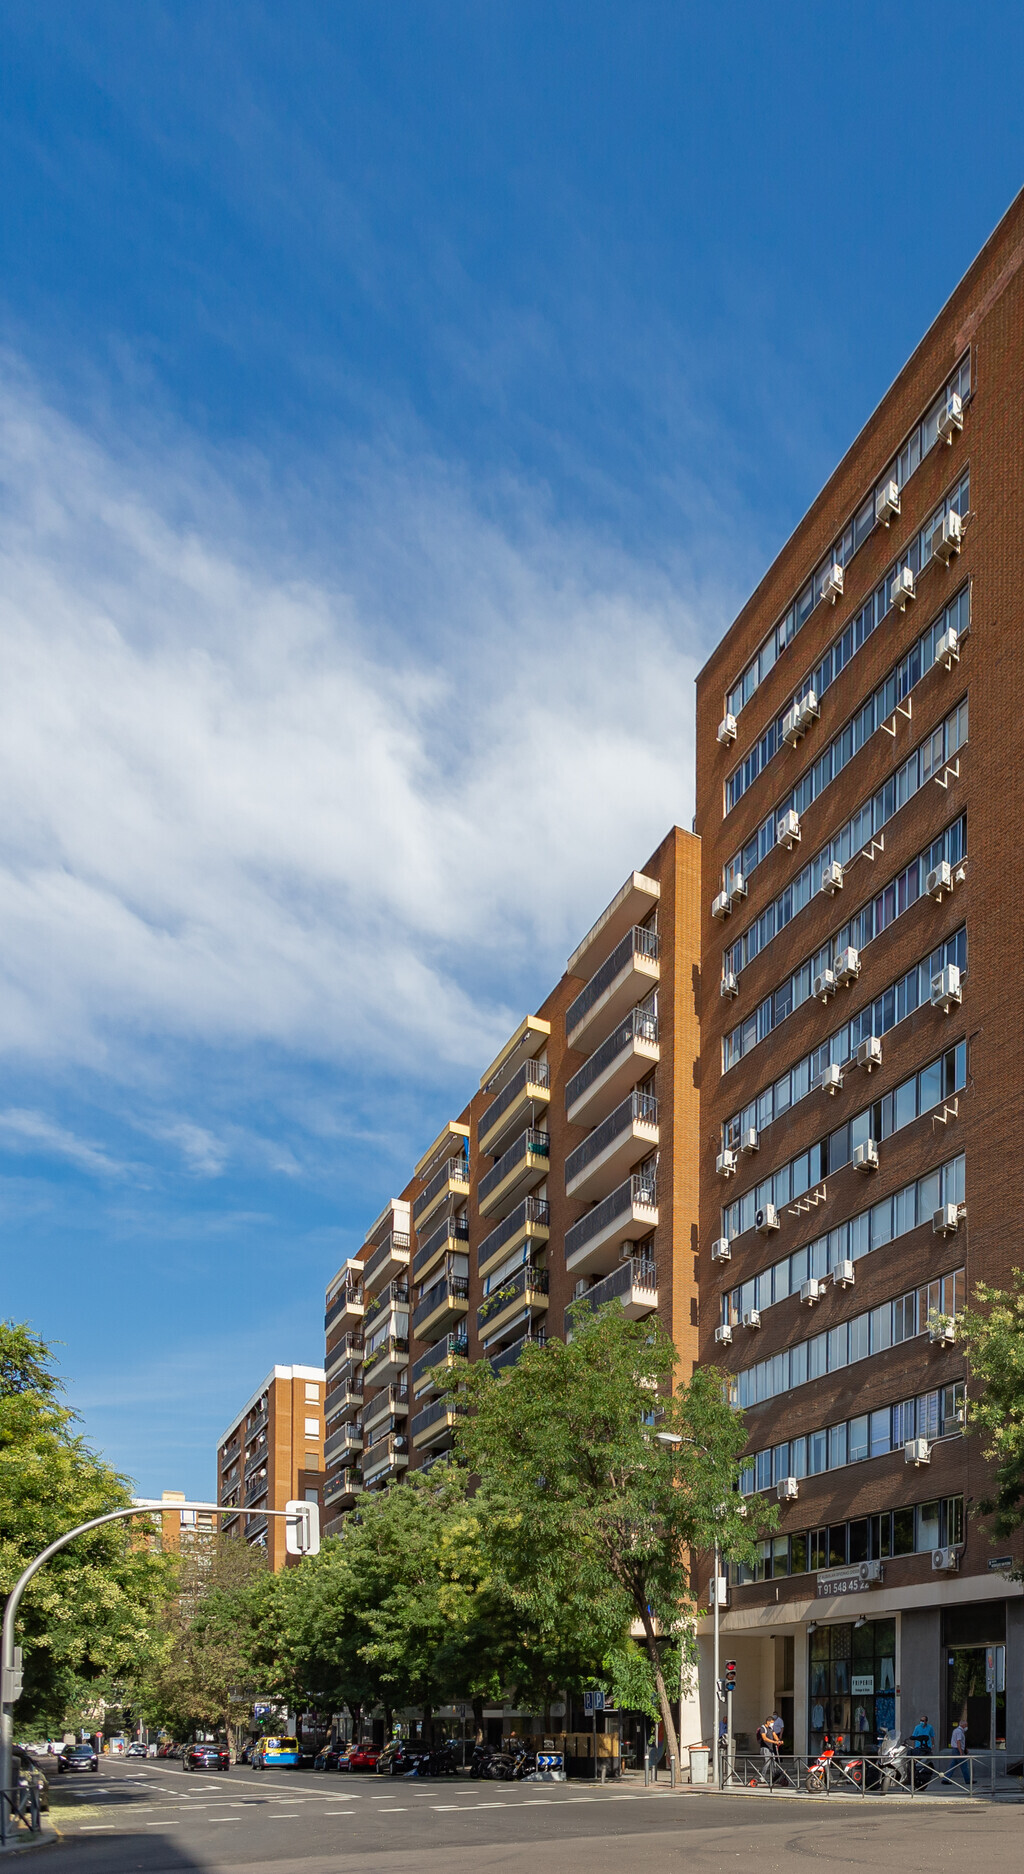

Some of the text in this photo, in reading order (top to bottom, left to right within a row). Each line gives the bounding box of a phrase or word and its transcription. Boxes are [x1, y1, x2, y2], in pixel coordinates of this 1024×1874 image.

[823, 1583, 832, 1595] 91
[833, 1581, 847, 1593] 548
[848, 1580, 859, 1591] 45
[596, 1693, 602, 1708] P
[256, 1707, 266, 1718] P
